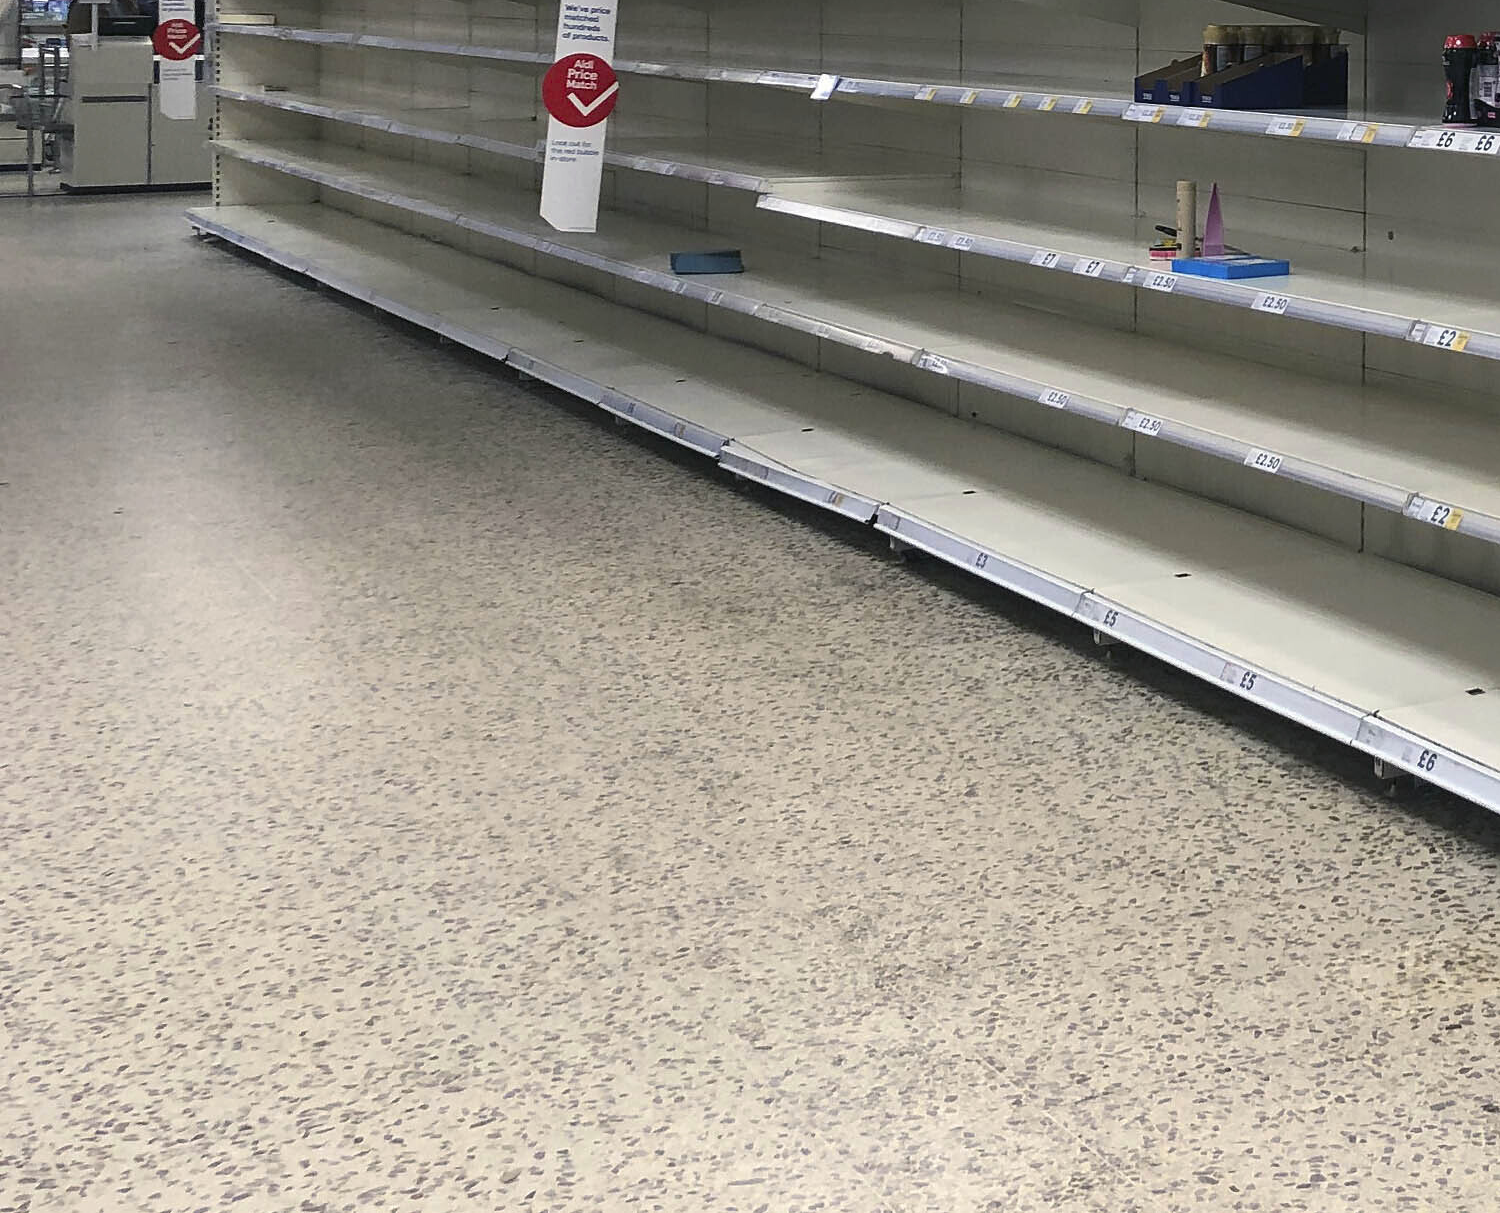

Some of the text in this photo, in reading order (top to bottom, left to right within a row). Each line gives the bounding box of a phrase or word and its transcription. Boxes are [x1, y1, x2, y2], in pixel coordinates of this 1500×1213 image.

[574, 59, 594, 70] Aldi
[568, 69, 598, 81] Price
[1436, 132, 1455, 149] £6
[1475, 135, 1495, 152] £6
[1263, 296, 1288, 311] £2.50
[1437, 330, 1456, 347] £2
[1139, 417, 1162, 432] £2.50
[1254, 452, 1280, 471] £2.50
[1430, 502, 1450, 525] £2
[976, 552, 988, 569] £3
[1104, 609, 1117, 628] £5
[1240, 671, 1257, 691] £5
[1417, 749, 1438, 772] £6
